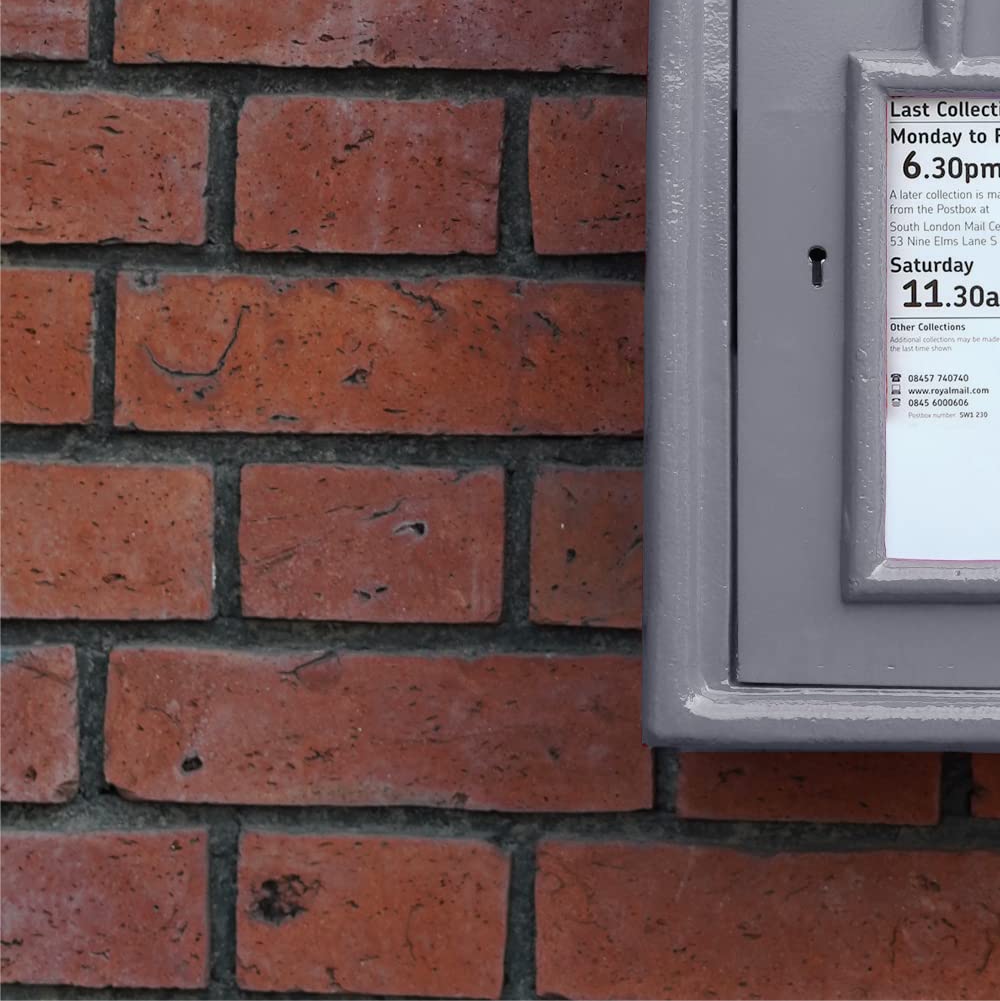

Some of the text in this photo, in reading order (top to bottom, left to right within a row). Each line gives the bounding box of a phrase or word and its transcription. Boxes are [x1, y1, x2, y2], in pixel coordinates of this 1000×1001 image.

[890, 101, 930, 117] Last
[891, 128, 962, 147] Monday
[969, 130, 987, 144] to
[890, 191, 897, 199] A
[900, 190, 921, 199] later
[926, 190, 972, 199] collection
[976, 190, 983, 199] is
[890, 204, 989, 214] from the Postbox at
[890, 222, 919, 232] South
[924, 222, 960, 231] London
[965, 221, 985, 231] Mail
[890, 237, 903, 246] 53
[908, 237, 930, 246] Nine
[935, 236, 958, 246] Elms
[962, 236, 986, 246] Lane
[891, 257, 974, 275] Saturday
[890, 323, 966, 331] Other Collections
[937, 374, 969, 382] 740740
[908, 387, 989, 395] www.royalmail.com
